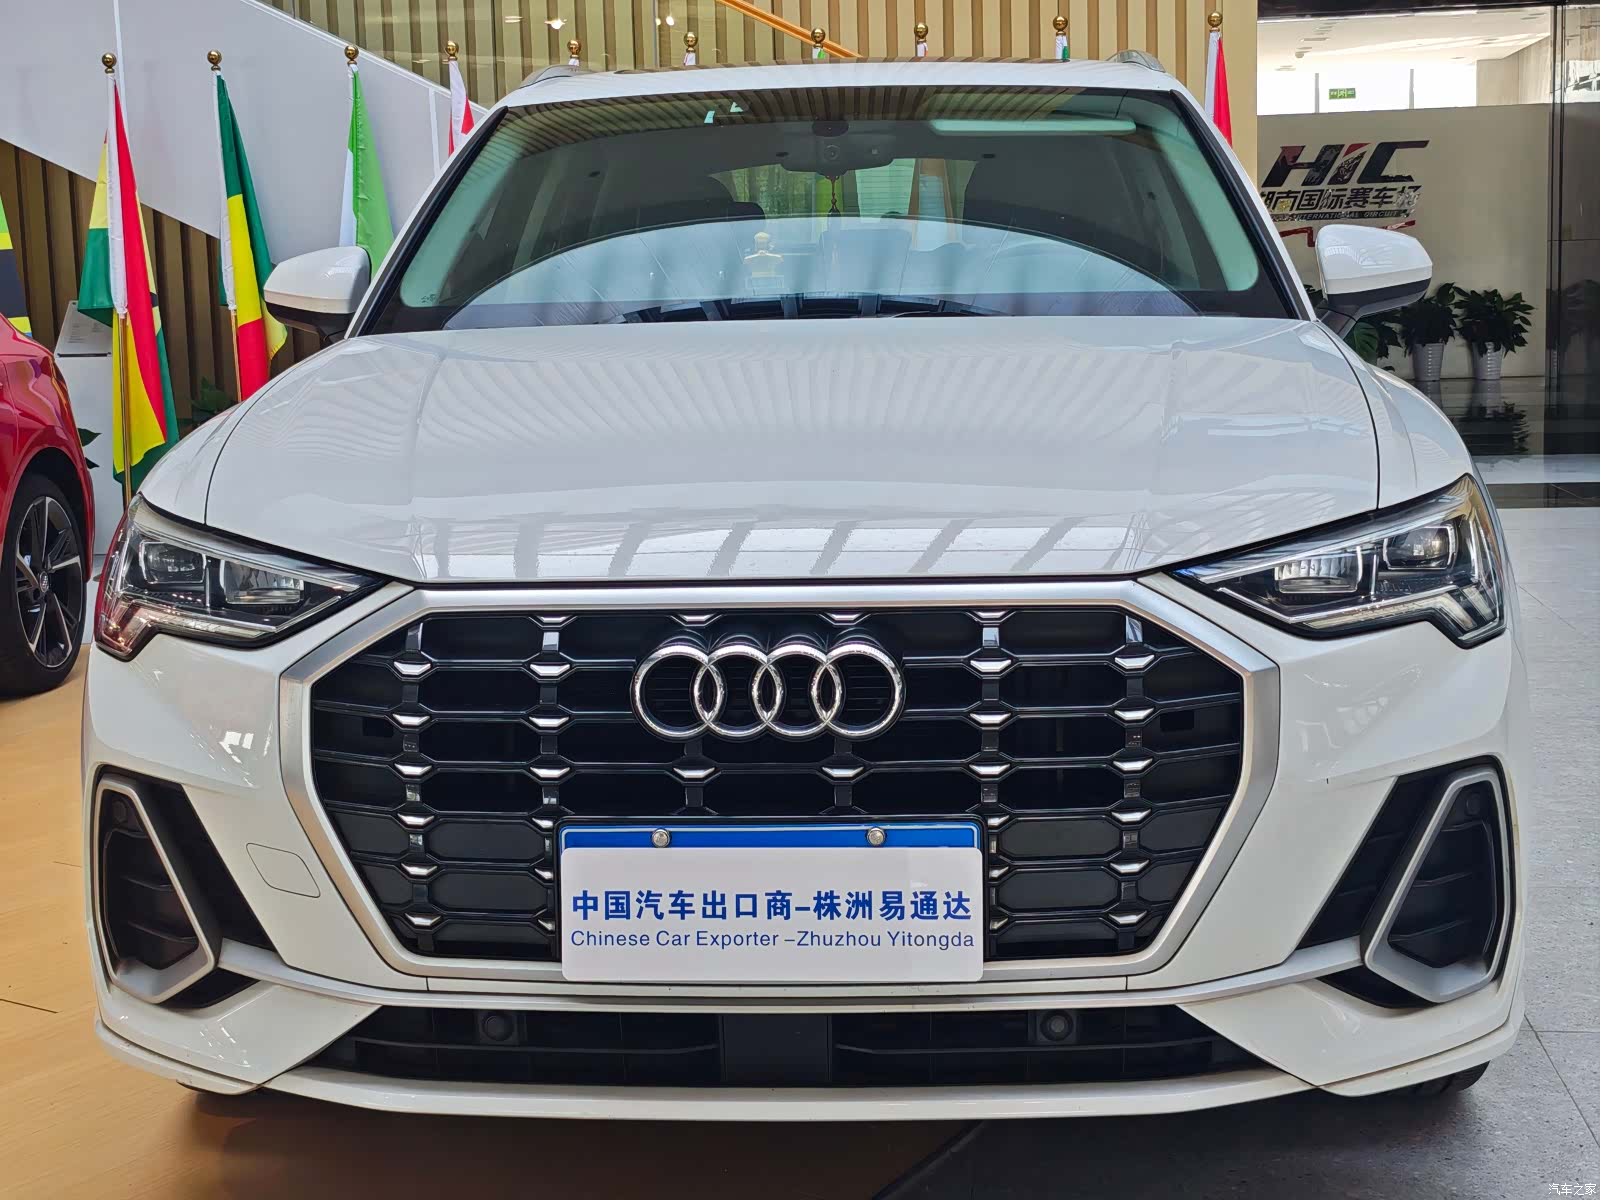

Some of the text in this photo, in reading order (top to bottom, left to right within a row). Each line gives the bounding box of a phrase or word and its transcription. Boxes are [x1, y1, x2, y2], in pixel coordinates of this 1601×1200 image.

[571, 889, 972, 921] 中国汽车出口商-株洲易通达
[570, 929, 650, 946] Chinese
[656, 929, 690, 946] Car
[696, 929, 778, 950] Exporter
[887, 930, 975, 951] Yitongda
